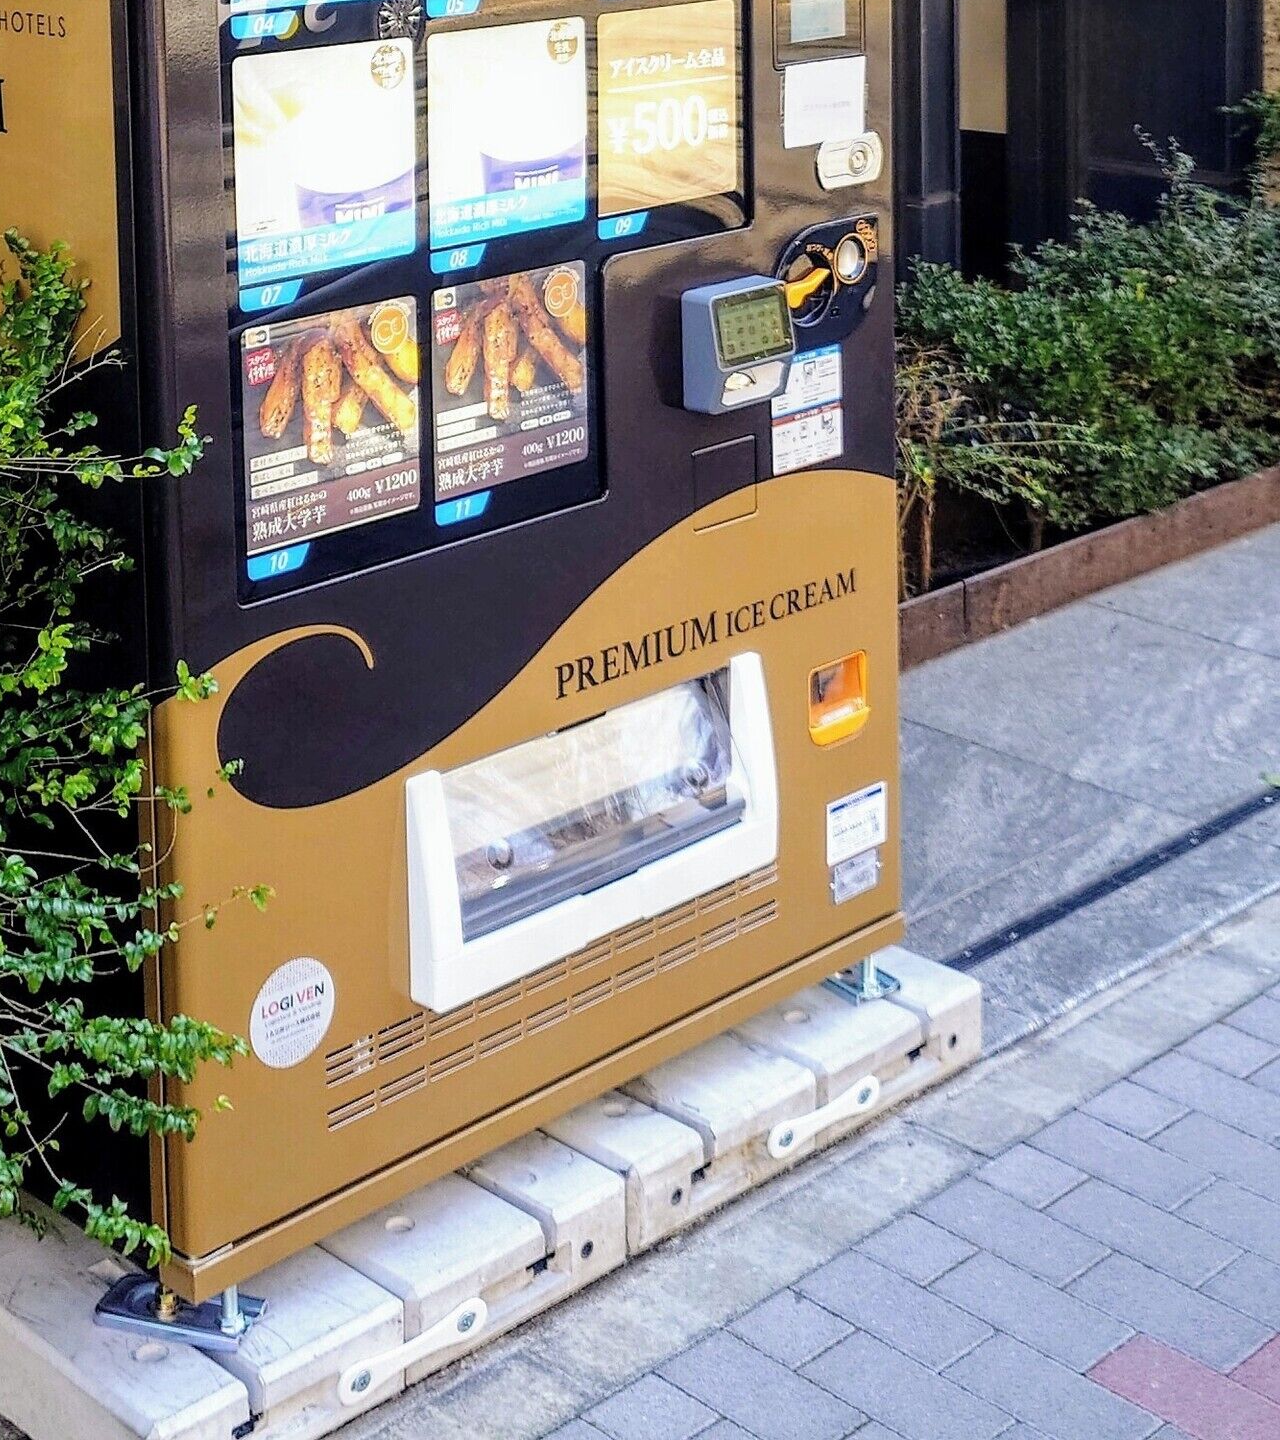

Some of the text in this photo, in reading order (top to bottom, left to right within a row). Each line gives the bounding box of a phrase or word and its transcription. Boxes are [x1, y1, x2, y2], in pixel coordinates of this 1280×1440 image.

[253, 16, 277, 34] 04
[609, 46, 727, 79] アイスクリーム全品
[607, 94, 709, 155] ¥500
[615, 217, 632, 235] 09
[449, 250, 468, 266] 08
[260, 287, 280, 306] 07
[522, 426, 584, 456] 400g ¥1200
[346, 469, 418, 502] 400g ¥1200
[438, 459, 505, 492] 熟成大学芋
[252, 505, 327, 542] 熟成大学芋
[455, 499, 471, 520] 11
[271, 551, 289, 572] 10
[555, 567, 857, 700] PREMIUM ICE CREAM
